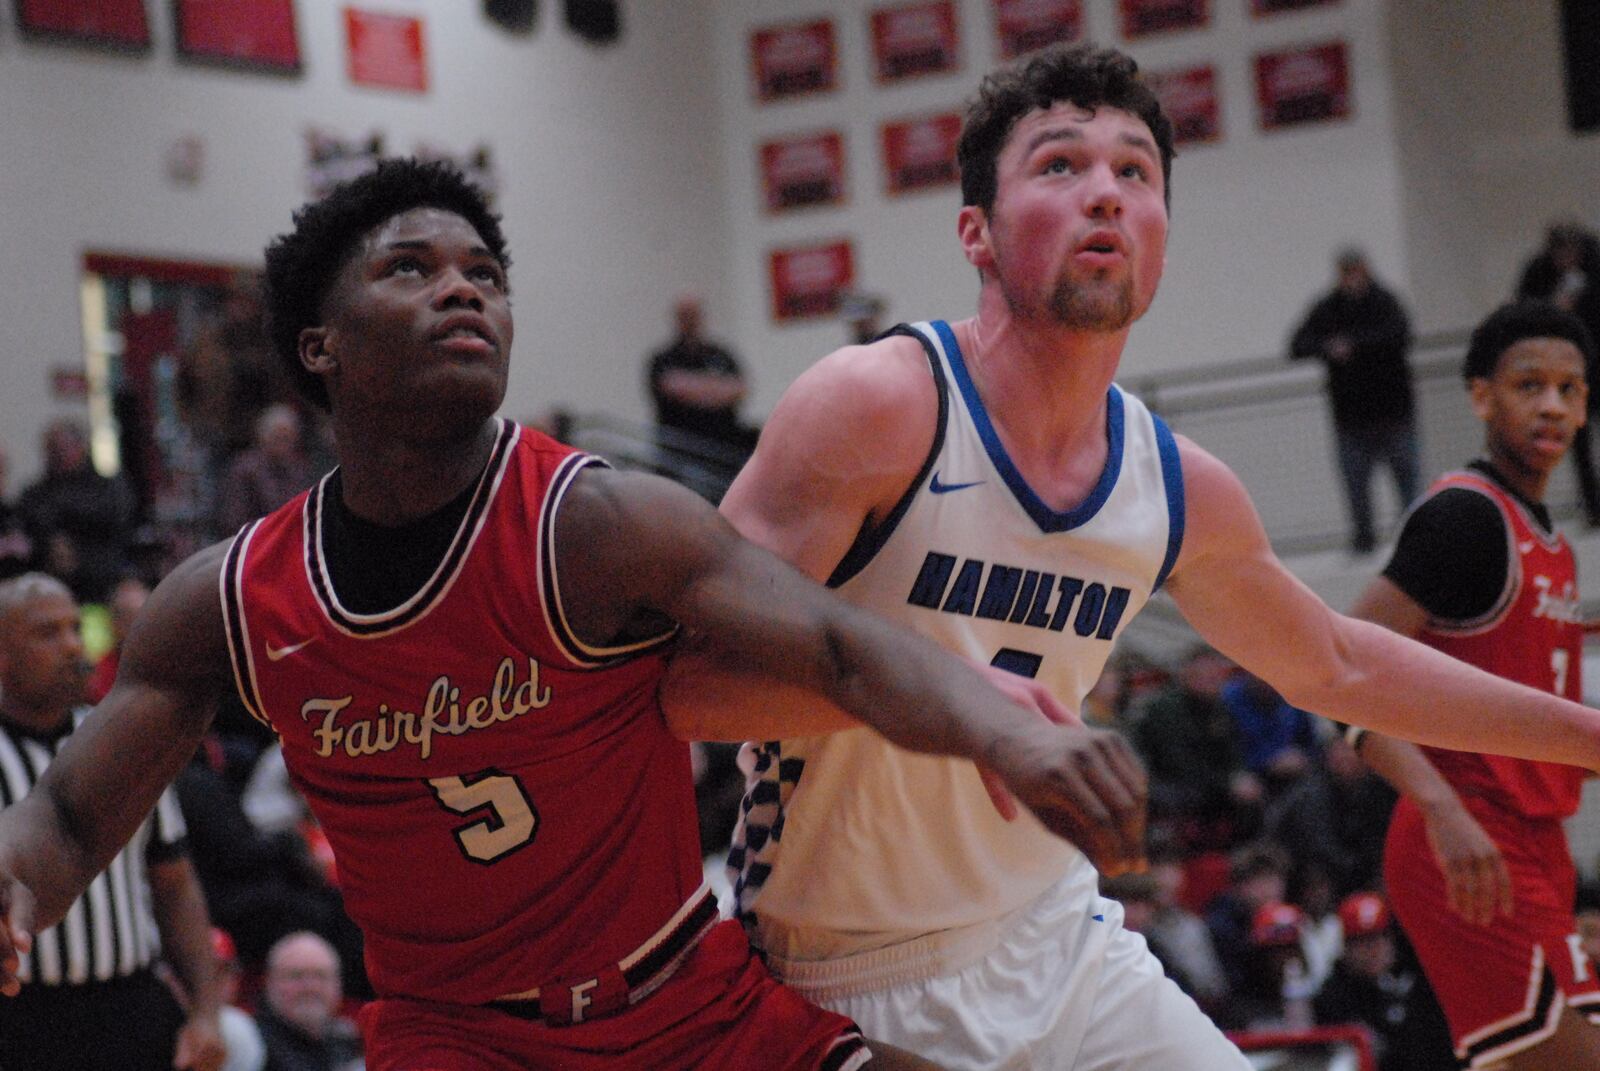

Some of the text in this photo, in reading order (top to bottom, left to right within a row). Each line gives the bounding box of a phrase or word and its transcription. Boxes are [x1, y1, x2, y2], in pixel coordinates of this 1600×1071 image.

[907, 551, 1131, 641] HAMILTON
[301, 656, 552, 760] Fairfield
[423, 767, 541, 866] 5
[569, 978, 598, 1022] F
